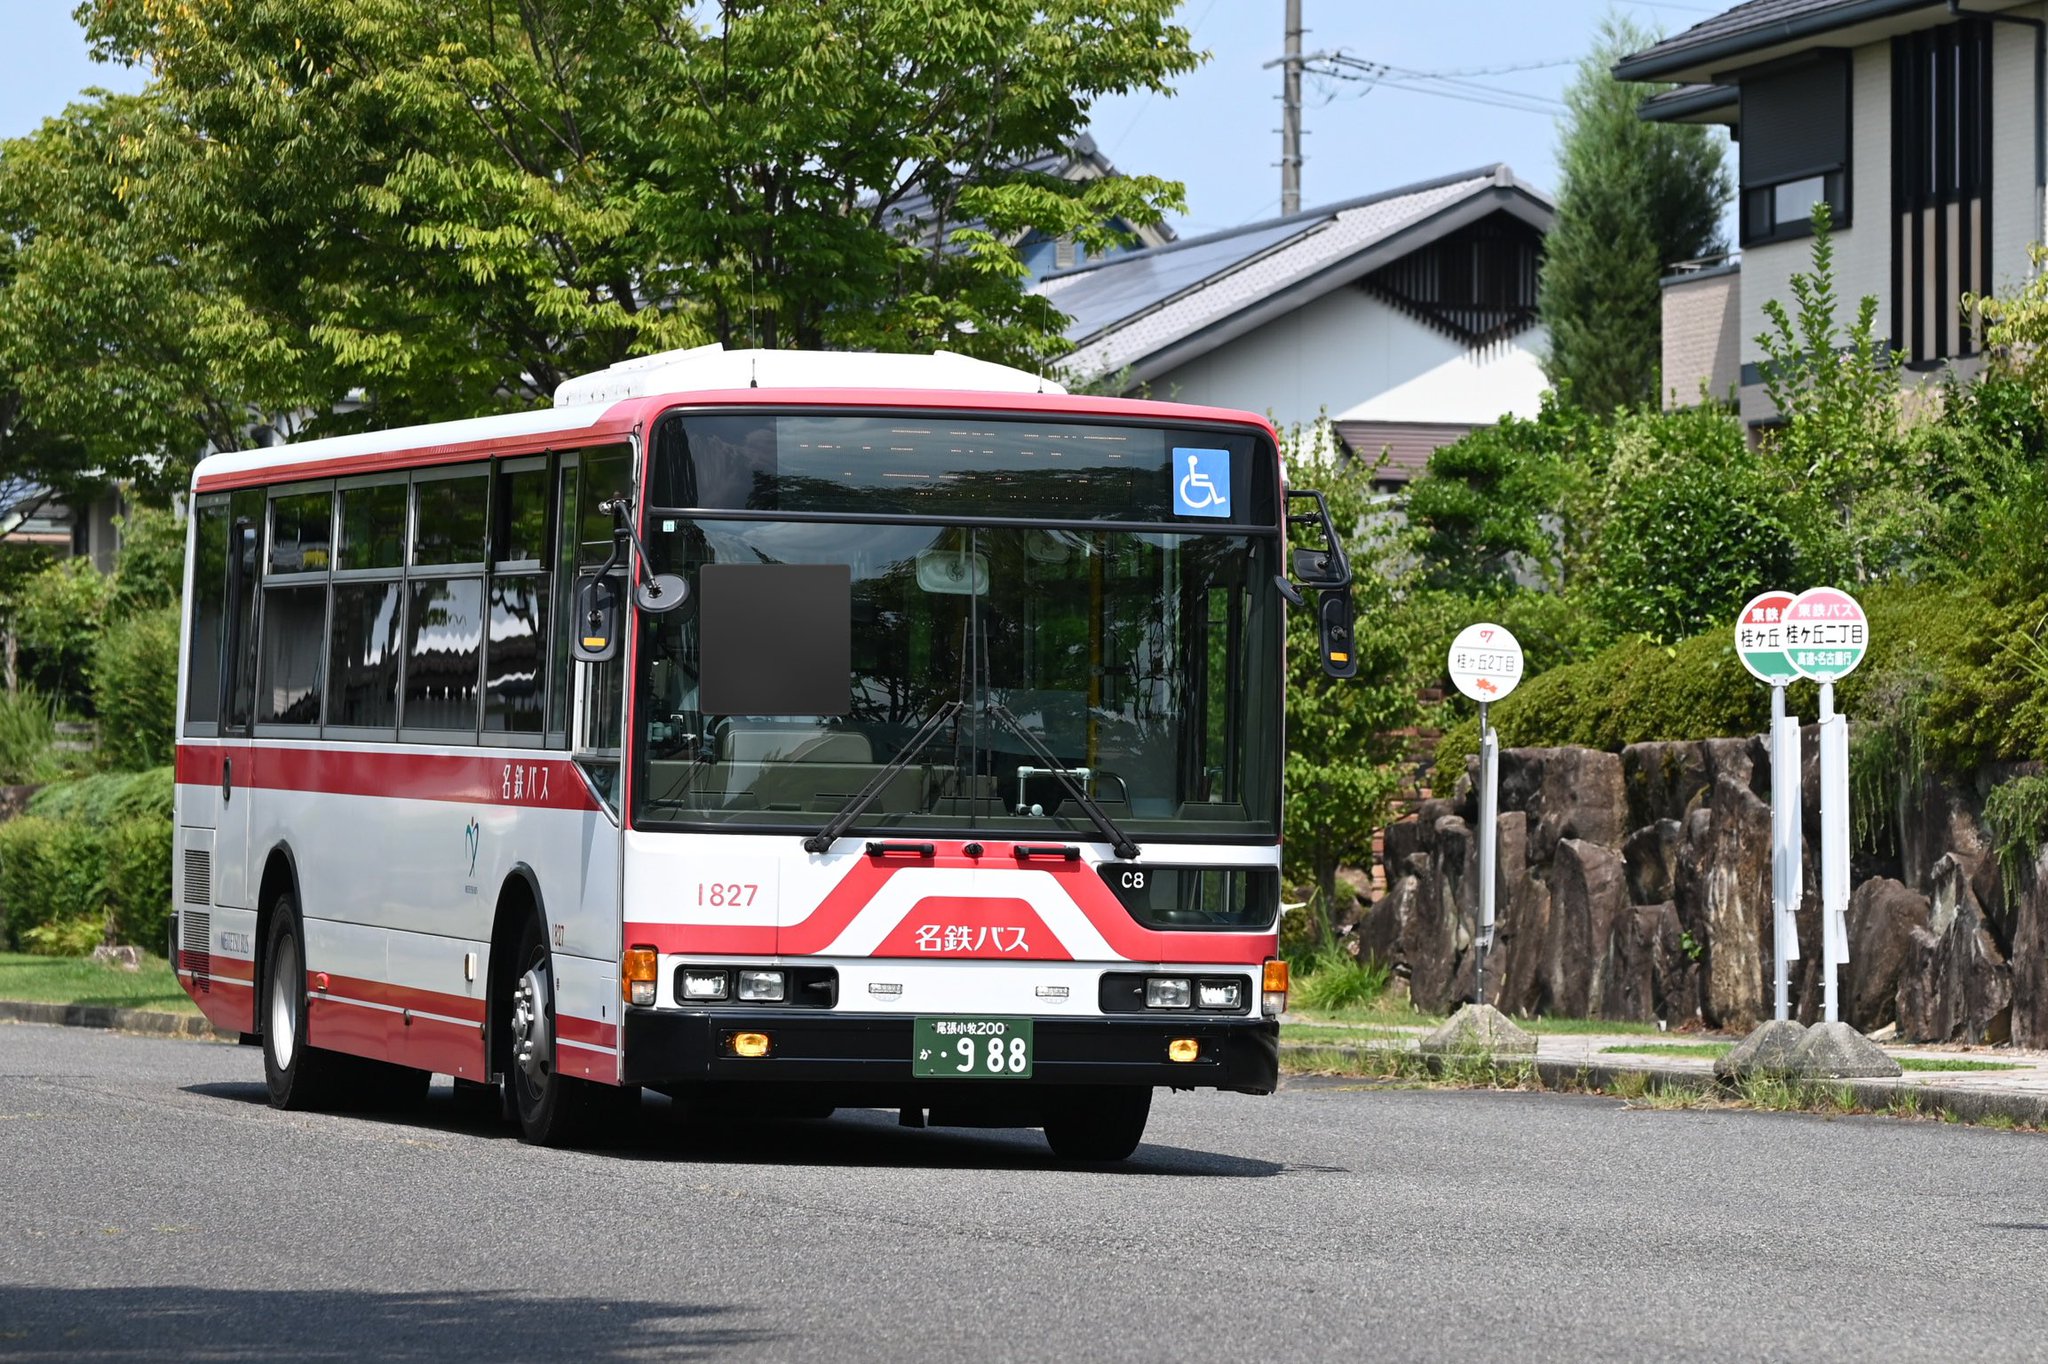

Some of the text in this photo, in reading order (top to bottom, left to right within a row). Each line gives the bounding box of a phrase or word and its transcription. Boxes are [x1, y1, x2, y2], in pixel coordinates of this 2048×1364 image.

[1751, 607, 1785, 623] 東鉄
[1798, 604, 1854, 617] 東鉄バス
[502, 764, 550, 801] 名鉄バス
[1121, 871, 1144, 888] C8
[698, 883, 758, 907] 1827
[915, 924, 1029, 952] 名鉄バス
